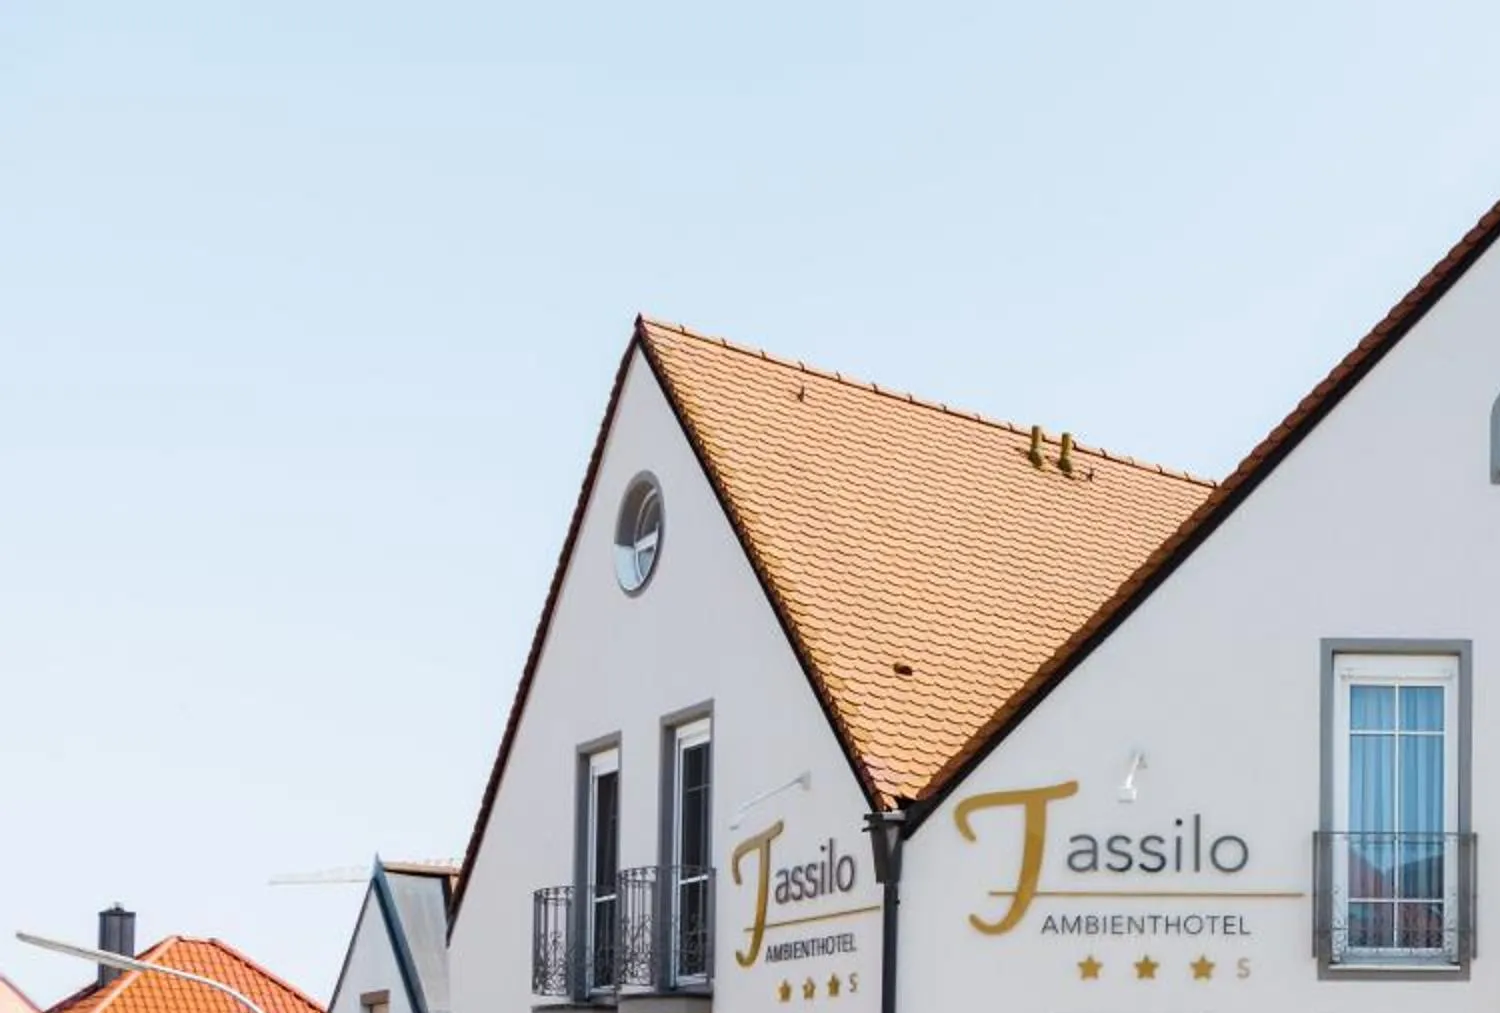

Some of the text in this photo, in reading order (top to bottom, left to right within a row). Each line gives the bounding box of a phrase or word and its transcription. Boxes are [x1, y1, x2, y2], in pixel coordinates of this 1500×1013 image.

[954, 780, 1250, 936] Tassilo
[731, 819, 856, 968] Tassilo
[1040, 914, 1251, 936] AMBIENTHOTEL
[765, 933, 857, 963] AMBIENTHOTEL
[1237, 956, 1251, 980] S
[848, 972, 858, 993] S
